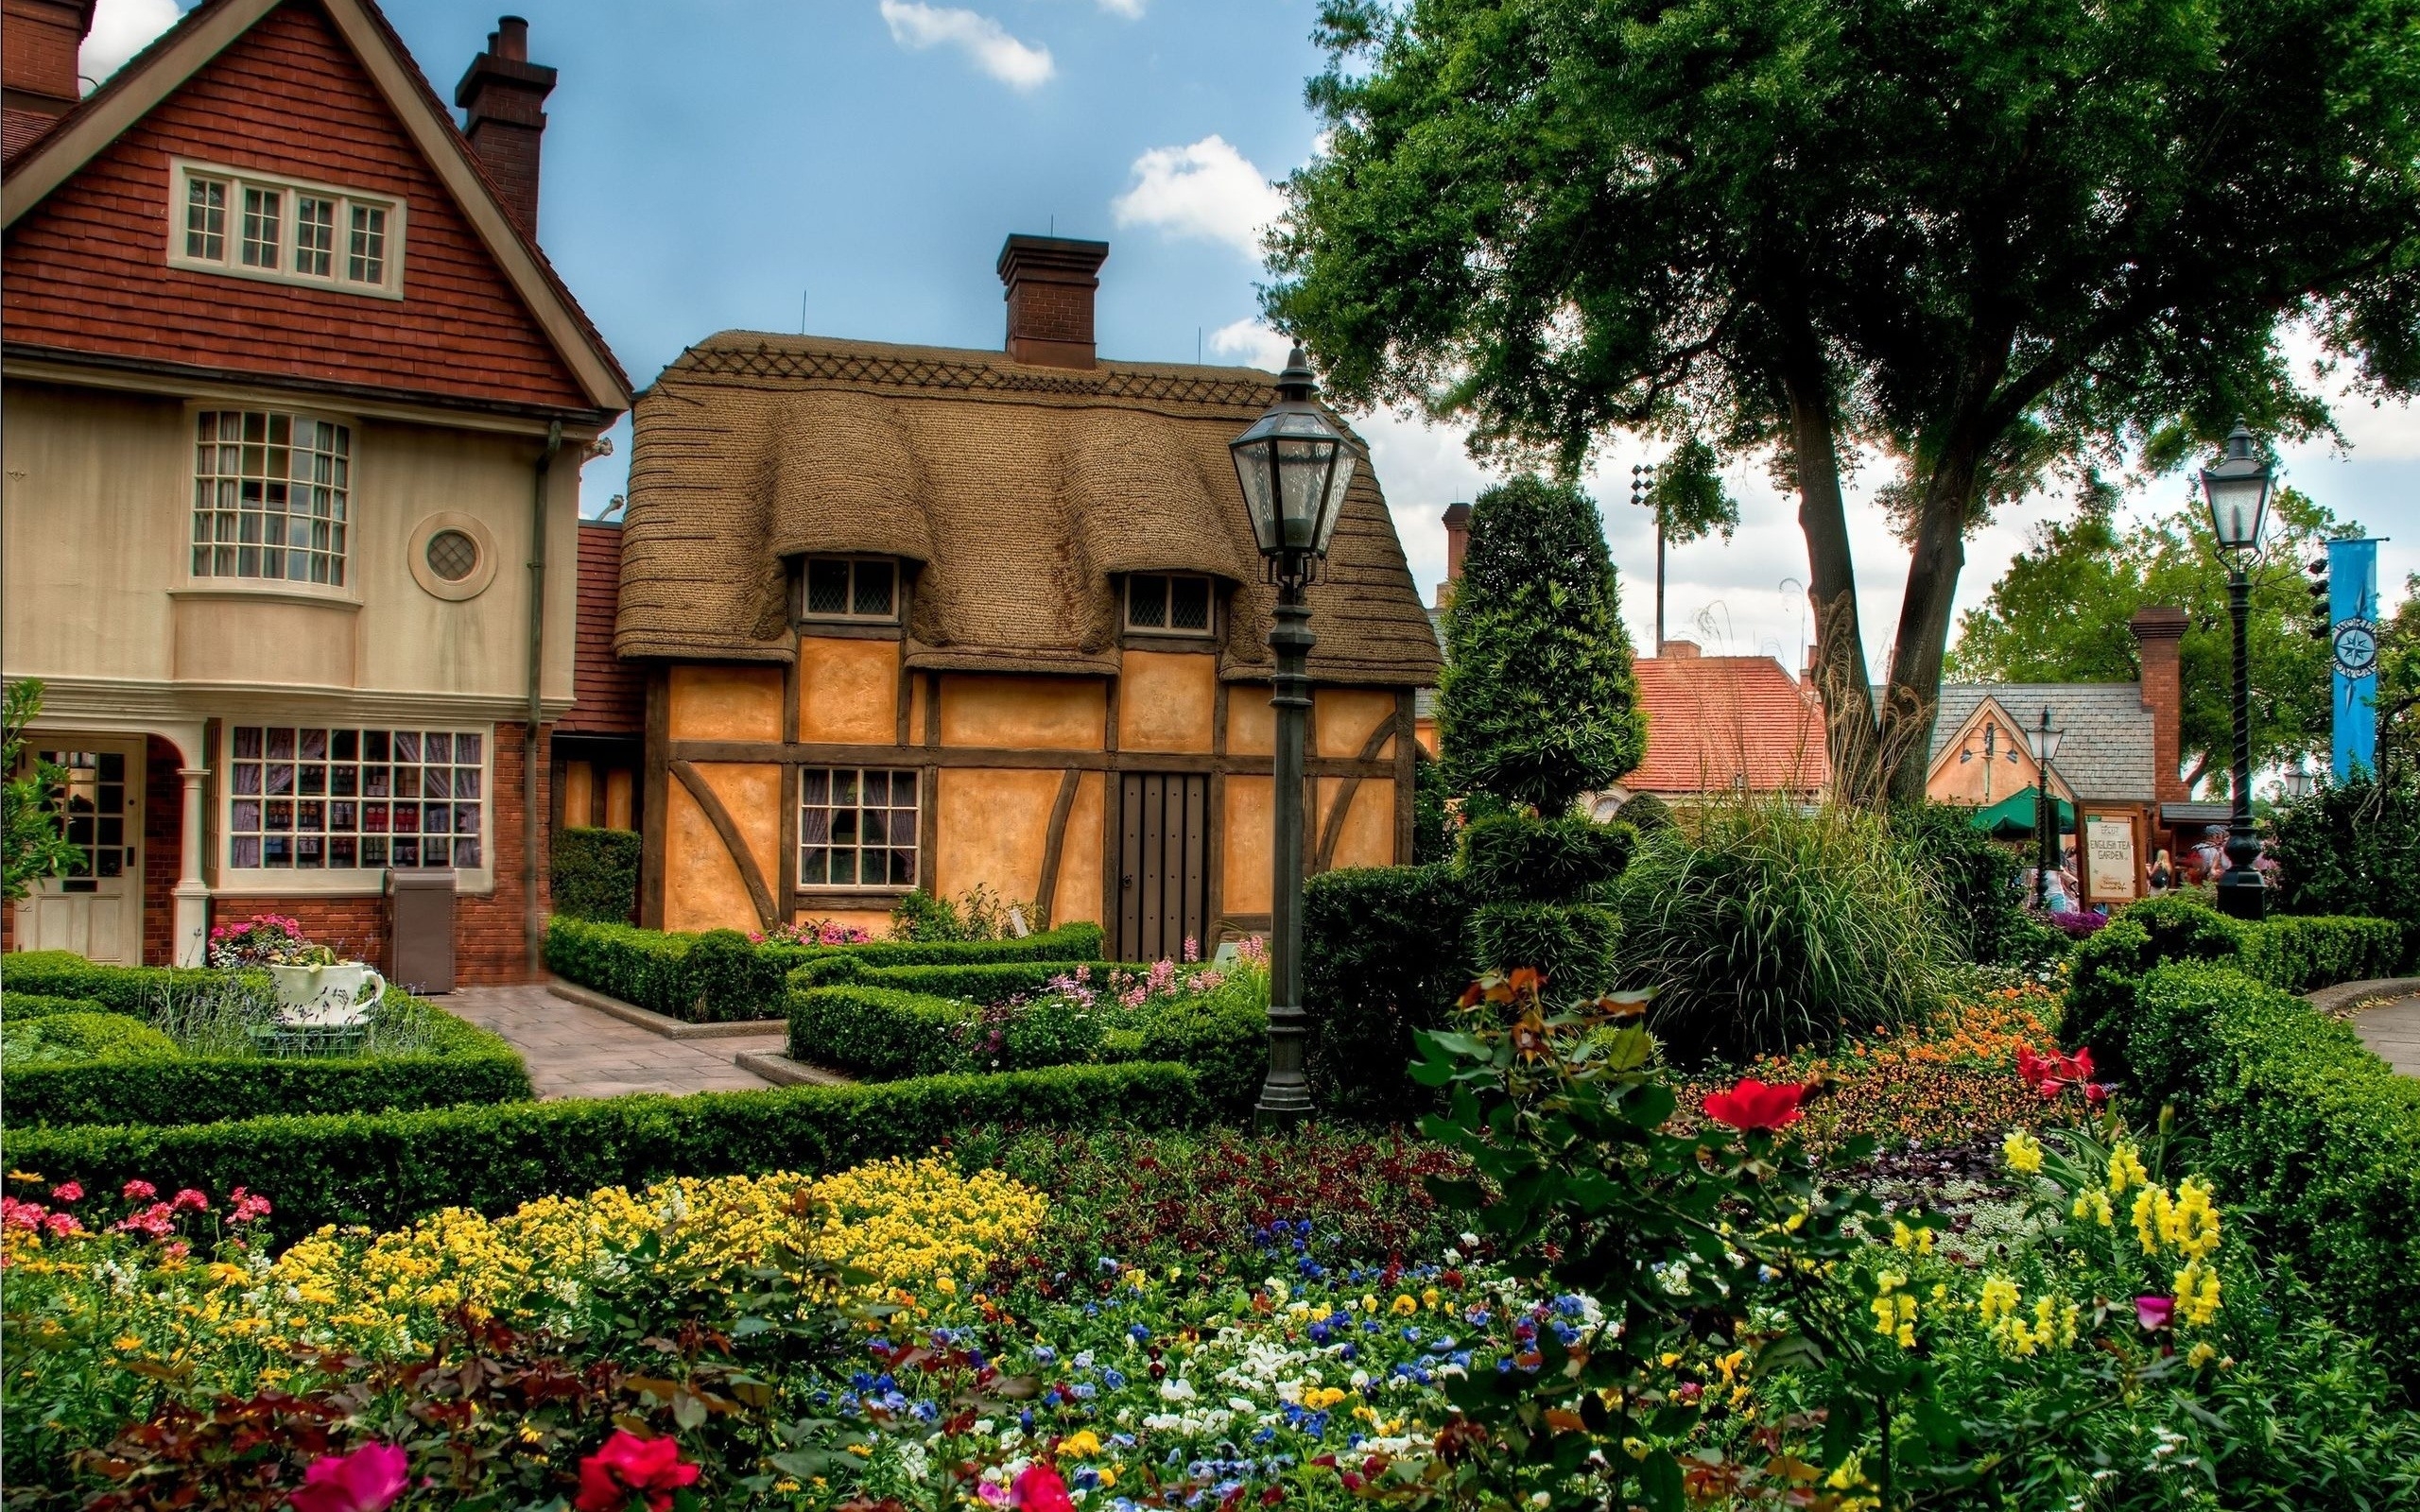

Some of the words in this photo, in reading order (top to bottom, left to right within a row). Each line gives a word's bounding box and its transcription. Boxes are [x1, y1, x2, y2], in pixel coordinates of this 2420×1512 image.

[2090, 840, 2117, 850] ENGLISH
[2118, 841, 2131, 850] TEA
[2098, 850, 2124, 860] GARDEN
